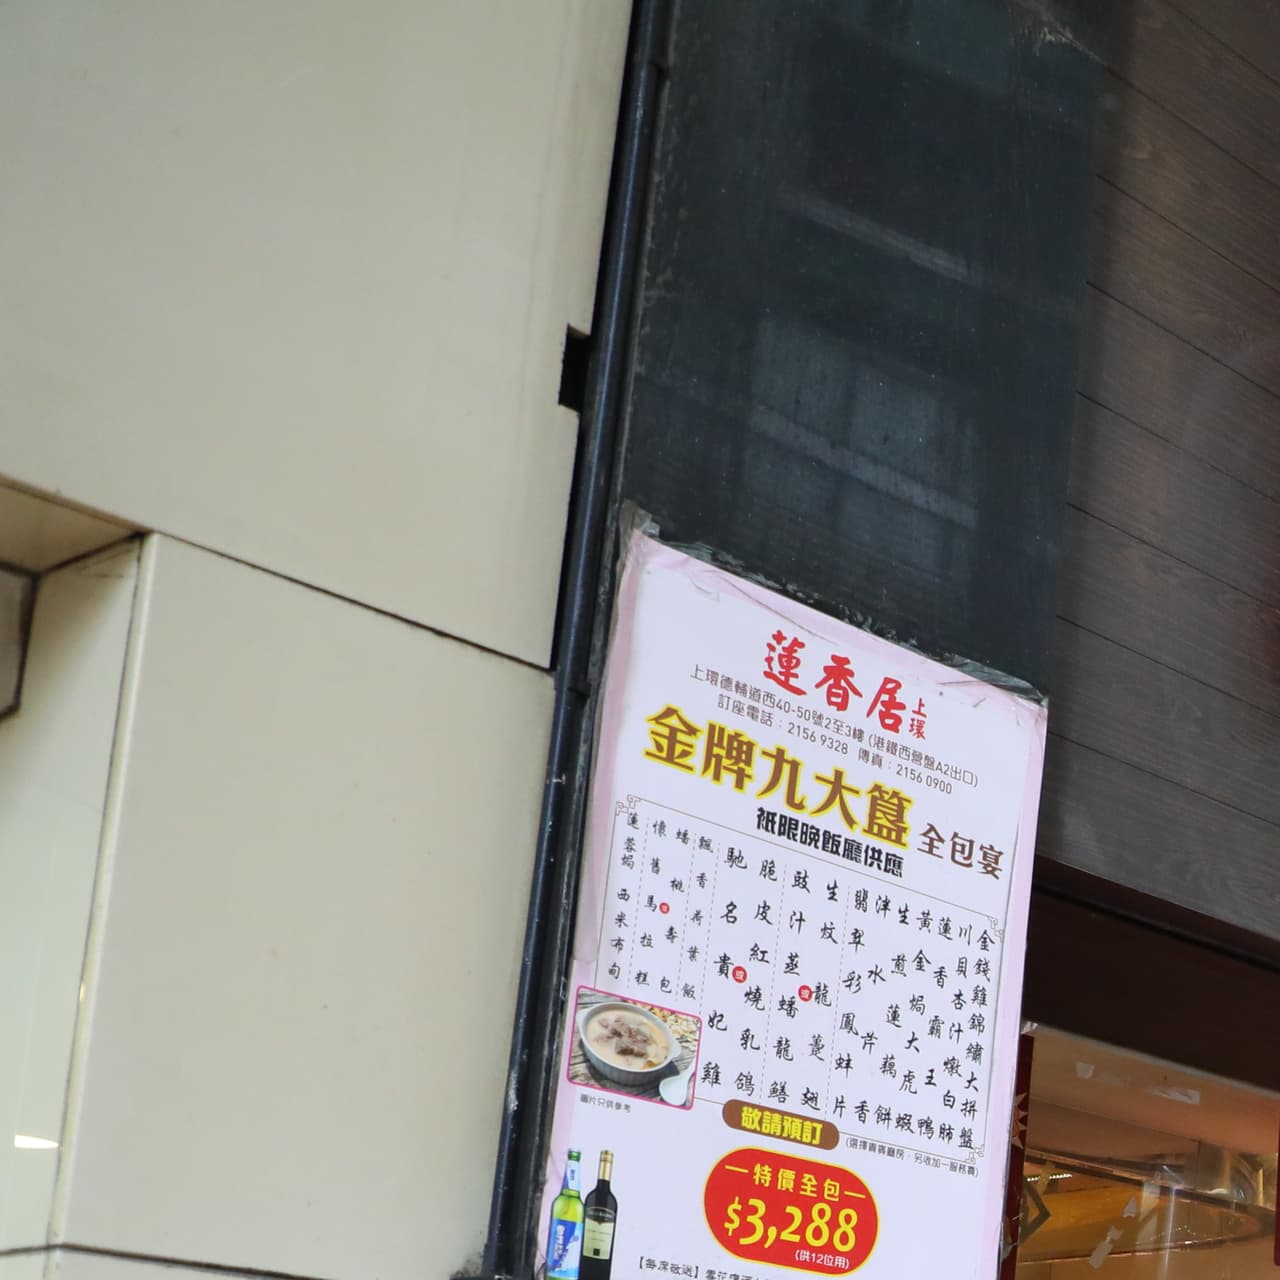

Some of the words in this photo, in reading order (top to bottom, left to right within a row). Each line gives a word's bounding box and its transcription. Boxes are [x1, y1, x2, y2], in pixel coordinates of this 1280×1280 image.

[763, 629, 908, 735] 蓮香居
[908, 697, 928, 741] 上環
[645, 704, 913, 849] 金牌九大簋
[917, 823, 1004, 881] 全包宴
[787, 720, 817, 745] 2156
[820, 731, 850, 757] 9328
[896, 762, 923, 785] 2156
[925, 771, 953, 796] 0900
[701, 846, 748, 1087] 馳名貴妃雞
[734, 859, 779, 1097] 脆皮紅燒乳鴿
[917, 916, 953, 1140] 蓮香霸王鴨
[740, 1105, 823, 1145] 敬請預訂
[722, 1195, 860, 1256] $3,288
[753, 1162, 841, 1202] 特價全包
